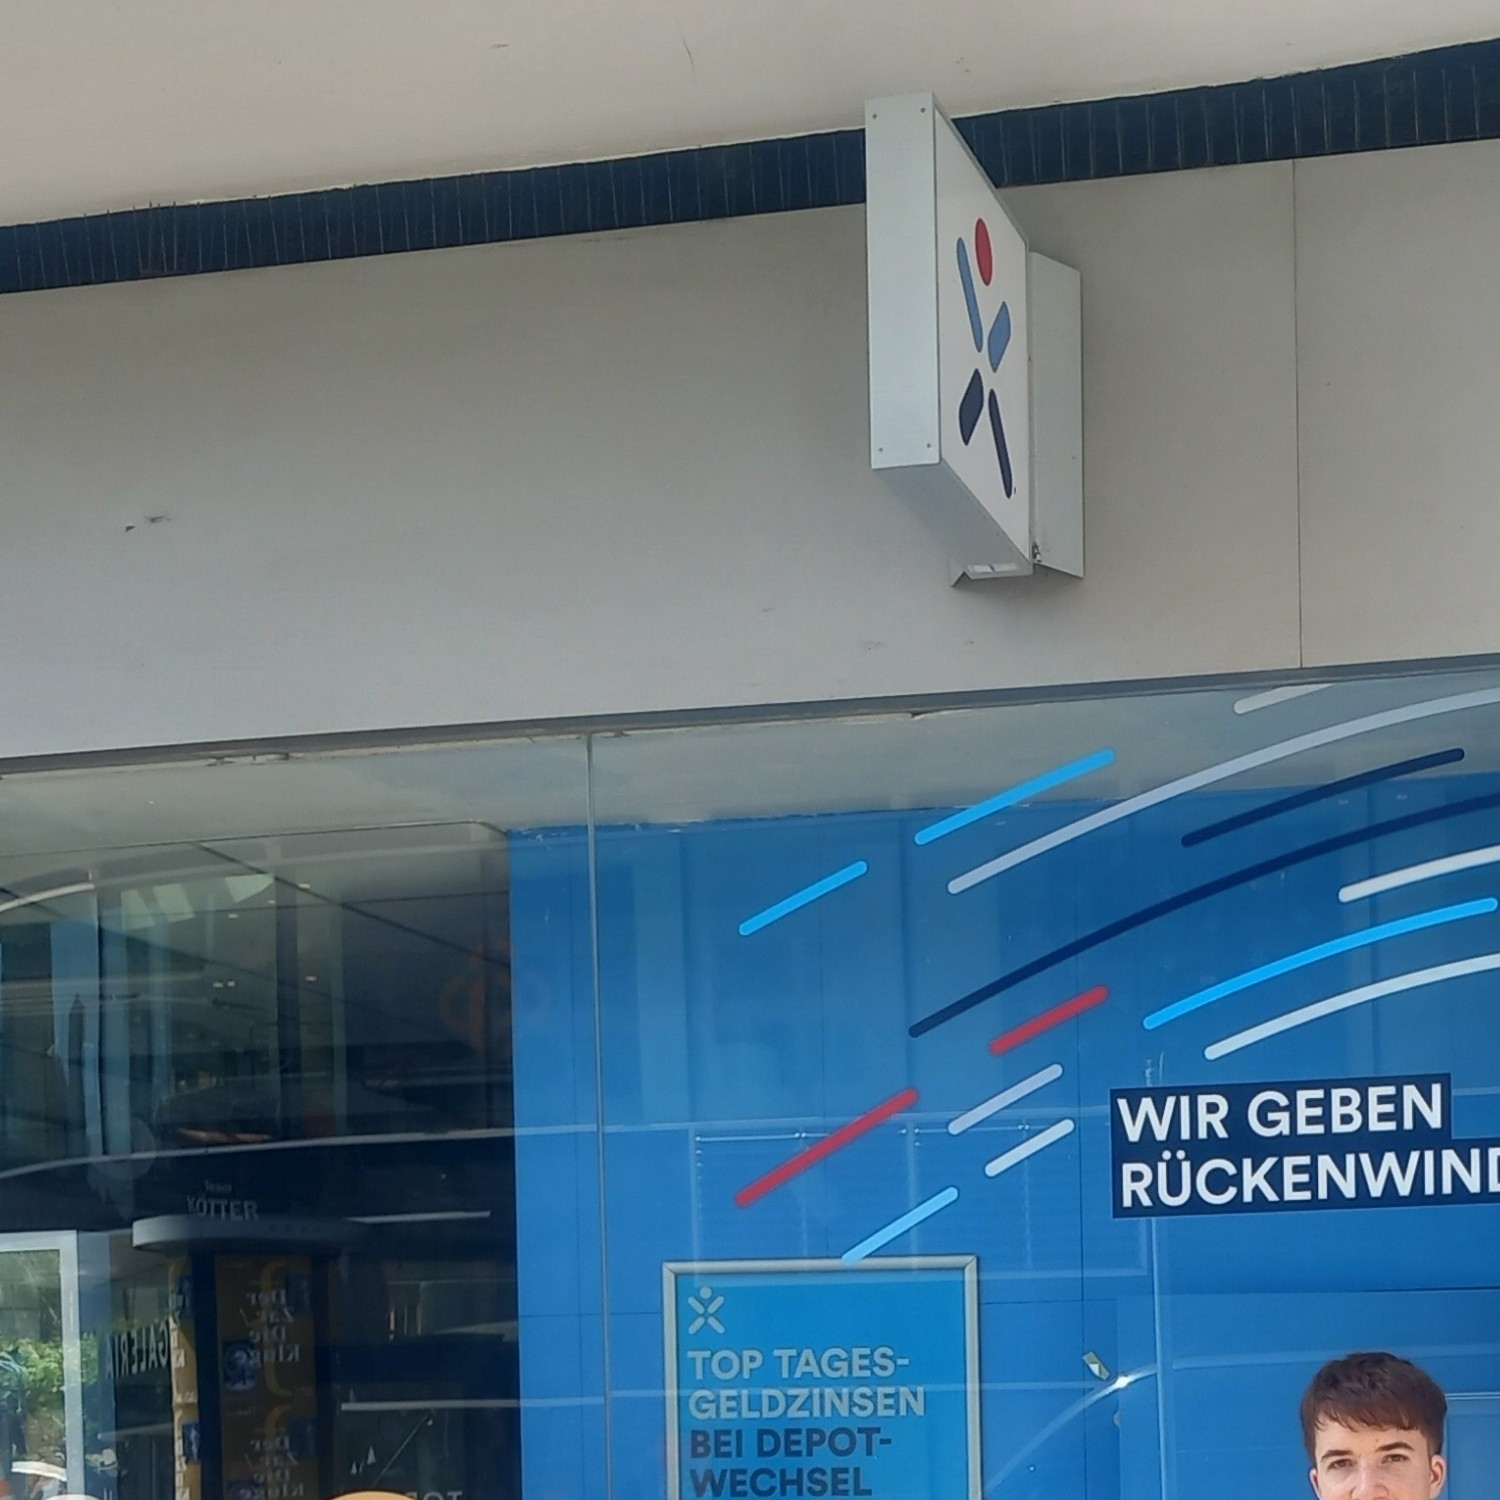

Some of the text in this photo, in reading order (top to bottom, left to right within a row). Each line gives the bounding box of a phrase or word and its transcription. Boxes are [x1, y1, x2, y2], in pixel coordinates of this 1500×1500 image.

[1117, 1083, 1442, 1142] WIR GEBEN
[687, 1346, 910, 1381] TOP TAGES-
[688, 1385, 926, 1420] GELDZINSEN
[690, 1426, 893, 1459] BEI DEPOT-
[690, 1467, 873, 1498] WECHSEL
